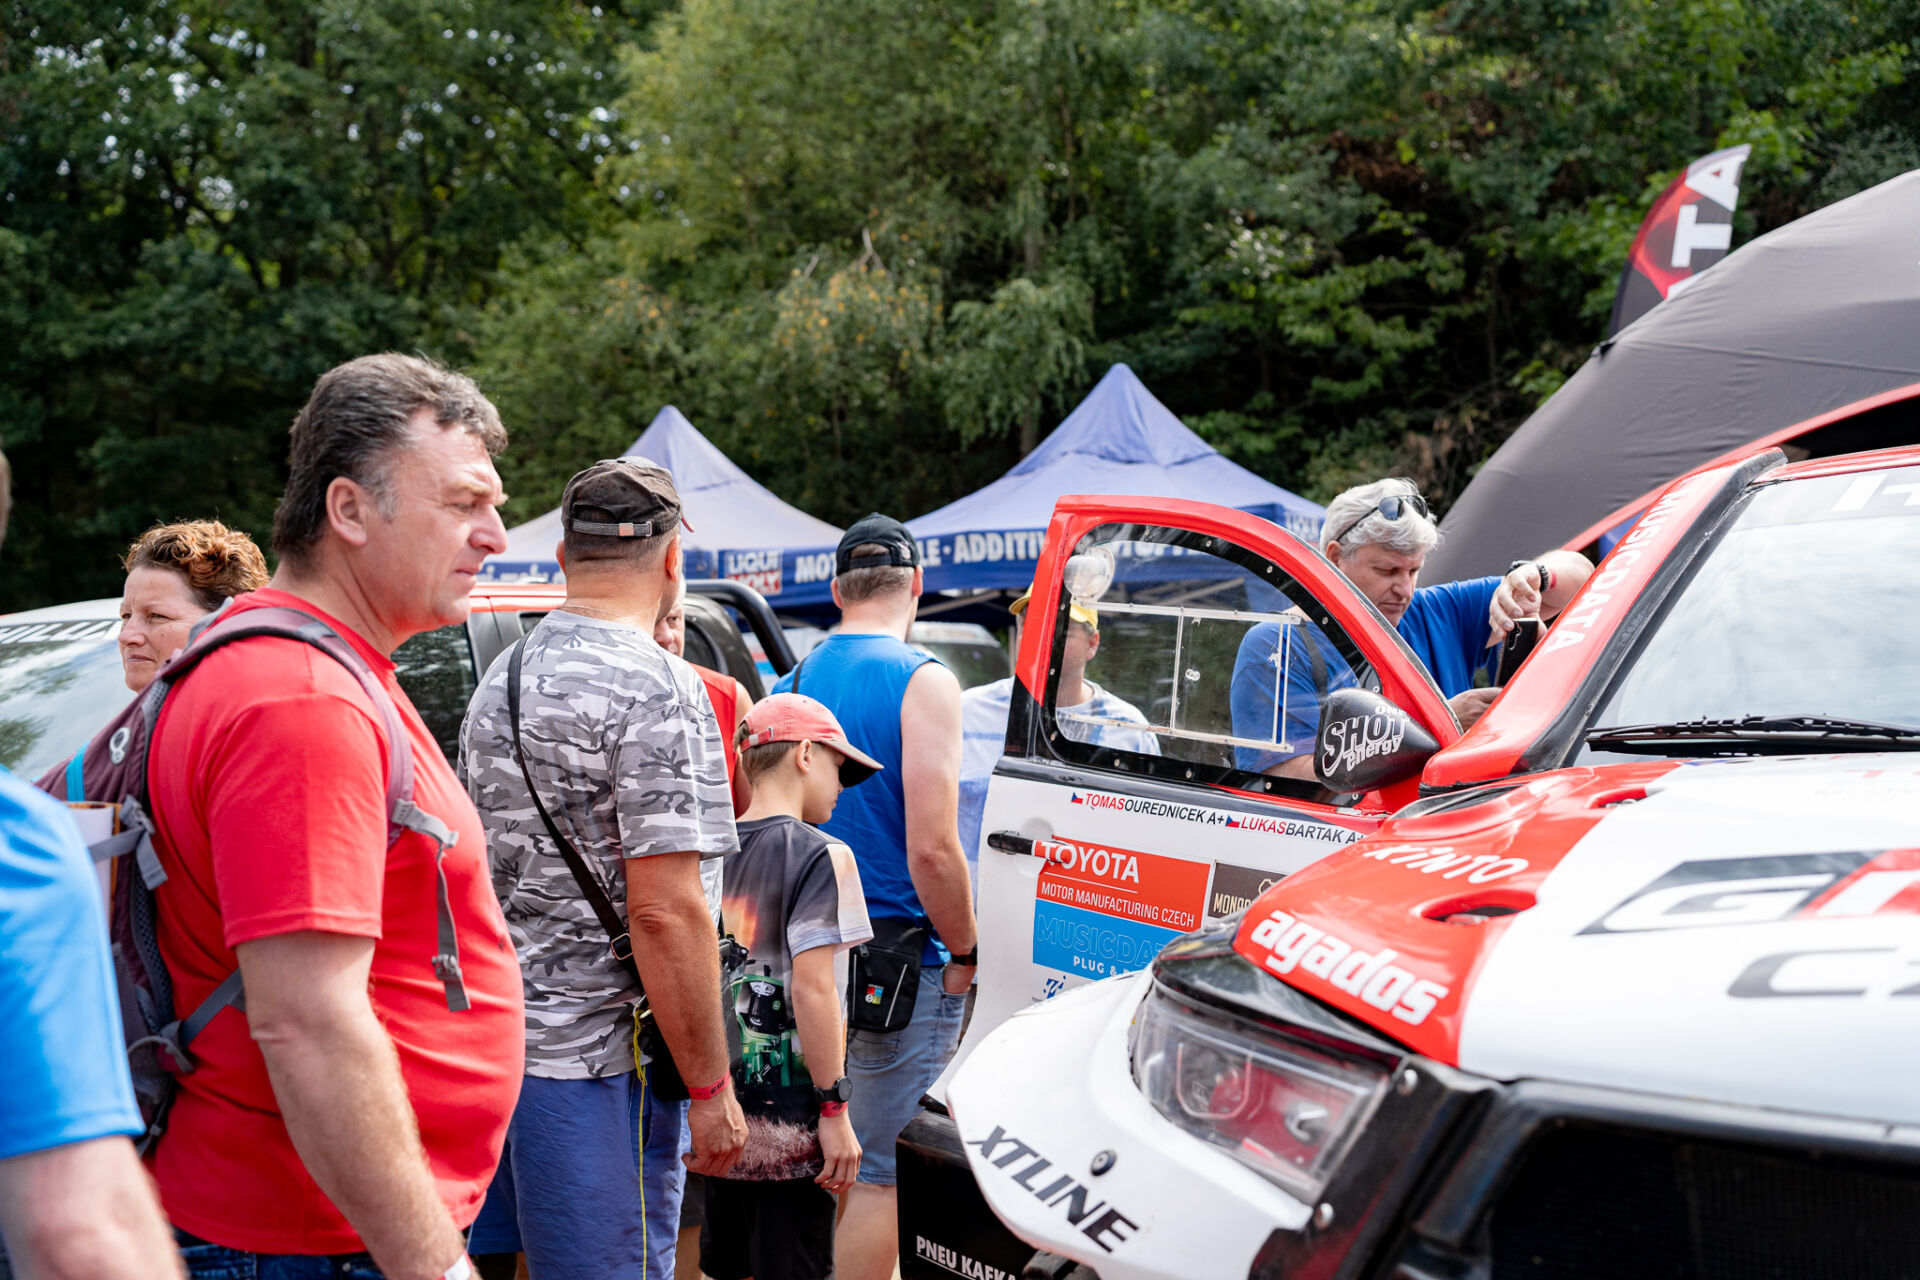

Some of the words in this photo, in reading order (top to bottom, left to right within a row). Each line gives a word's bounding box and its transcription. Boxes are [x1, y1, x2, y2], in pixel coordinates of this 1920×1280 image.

[1322, 714, 1410, 777] SHOT
[1343, 737, 1402, 772] energy
[1206, 812, 1225, 825] A+
[1041, 842, 1140, 884] TOYOTA
[1041, 882, 1074, 901] MOTOR
[1075, 889, 1160, 920] MANUFACTURING
[1161, 908, 1195, 929] CZECH
[1073, 955, 1105, 974] PLUG
[1250, 909, 1450, 1026] agados
[965, 1125, 1140, 1254] XTLINE
[916, 1235, 957, 1269] PNEU
